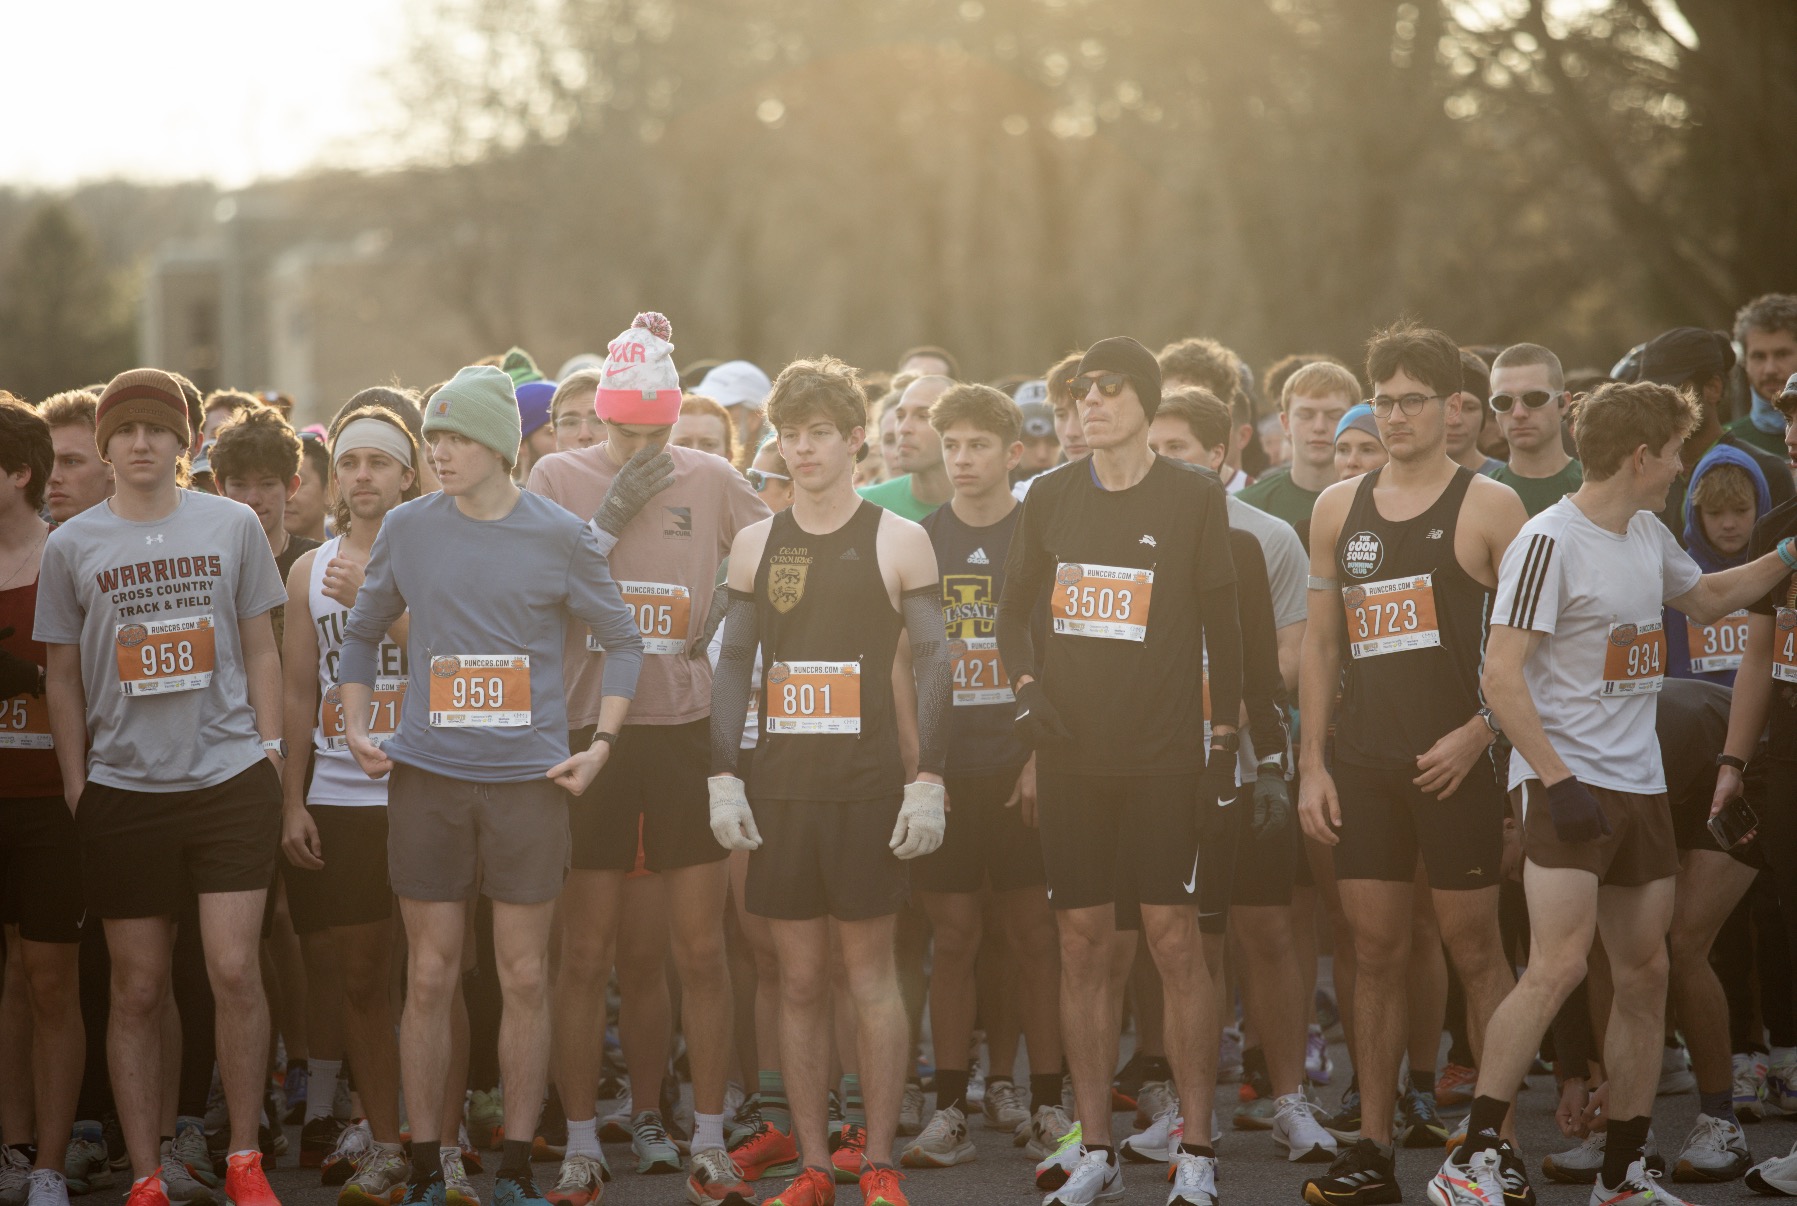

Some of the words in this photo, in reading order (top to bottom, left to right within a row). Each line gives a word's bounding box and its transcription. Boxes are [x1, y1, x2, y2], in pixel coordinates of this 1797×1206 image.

[1346, 551, 1377, 561] SQUAD
[96, 555, 222, 593] WARRIORS
[1087, 569, 1132, 580] RUNCCRS.COM
[1369, 581, 1411, 595] RUNCCRS.COM
[111, 587, 154, 604] CROSS
[156, 580, 214, 596] COUNTRY
[626, 586, 669, 595] RUNCCRS.COM
[1065, 586, 1132, 620] 3503
[118, 602, 161, 618] TRACK
[164, 600, 172, 611] &
[176, 595, 211, 609] FIELD
[1355, 599, 1418, 638] 3723
[151, 622, 195, 634] RUNCCRS.COM
[141, 641, 194, 676] 958
[793, 666, 839, 674] RUNCCRS.COM
[1627, 641, 1660, 676] 934
[953, 659, 1010, 687] 421
[452, 677, 503, 708] 959
[783, 684, 831, 715] 801
[335, 701, 395, 732] 371
